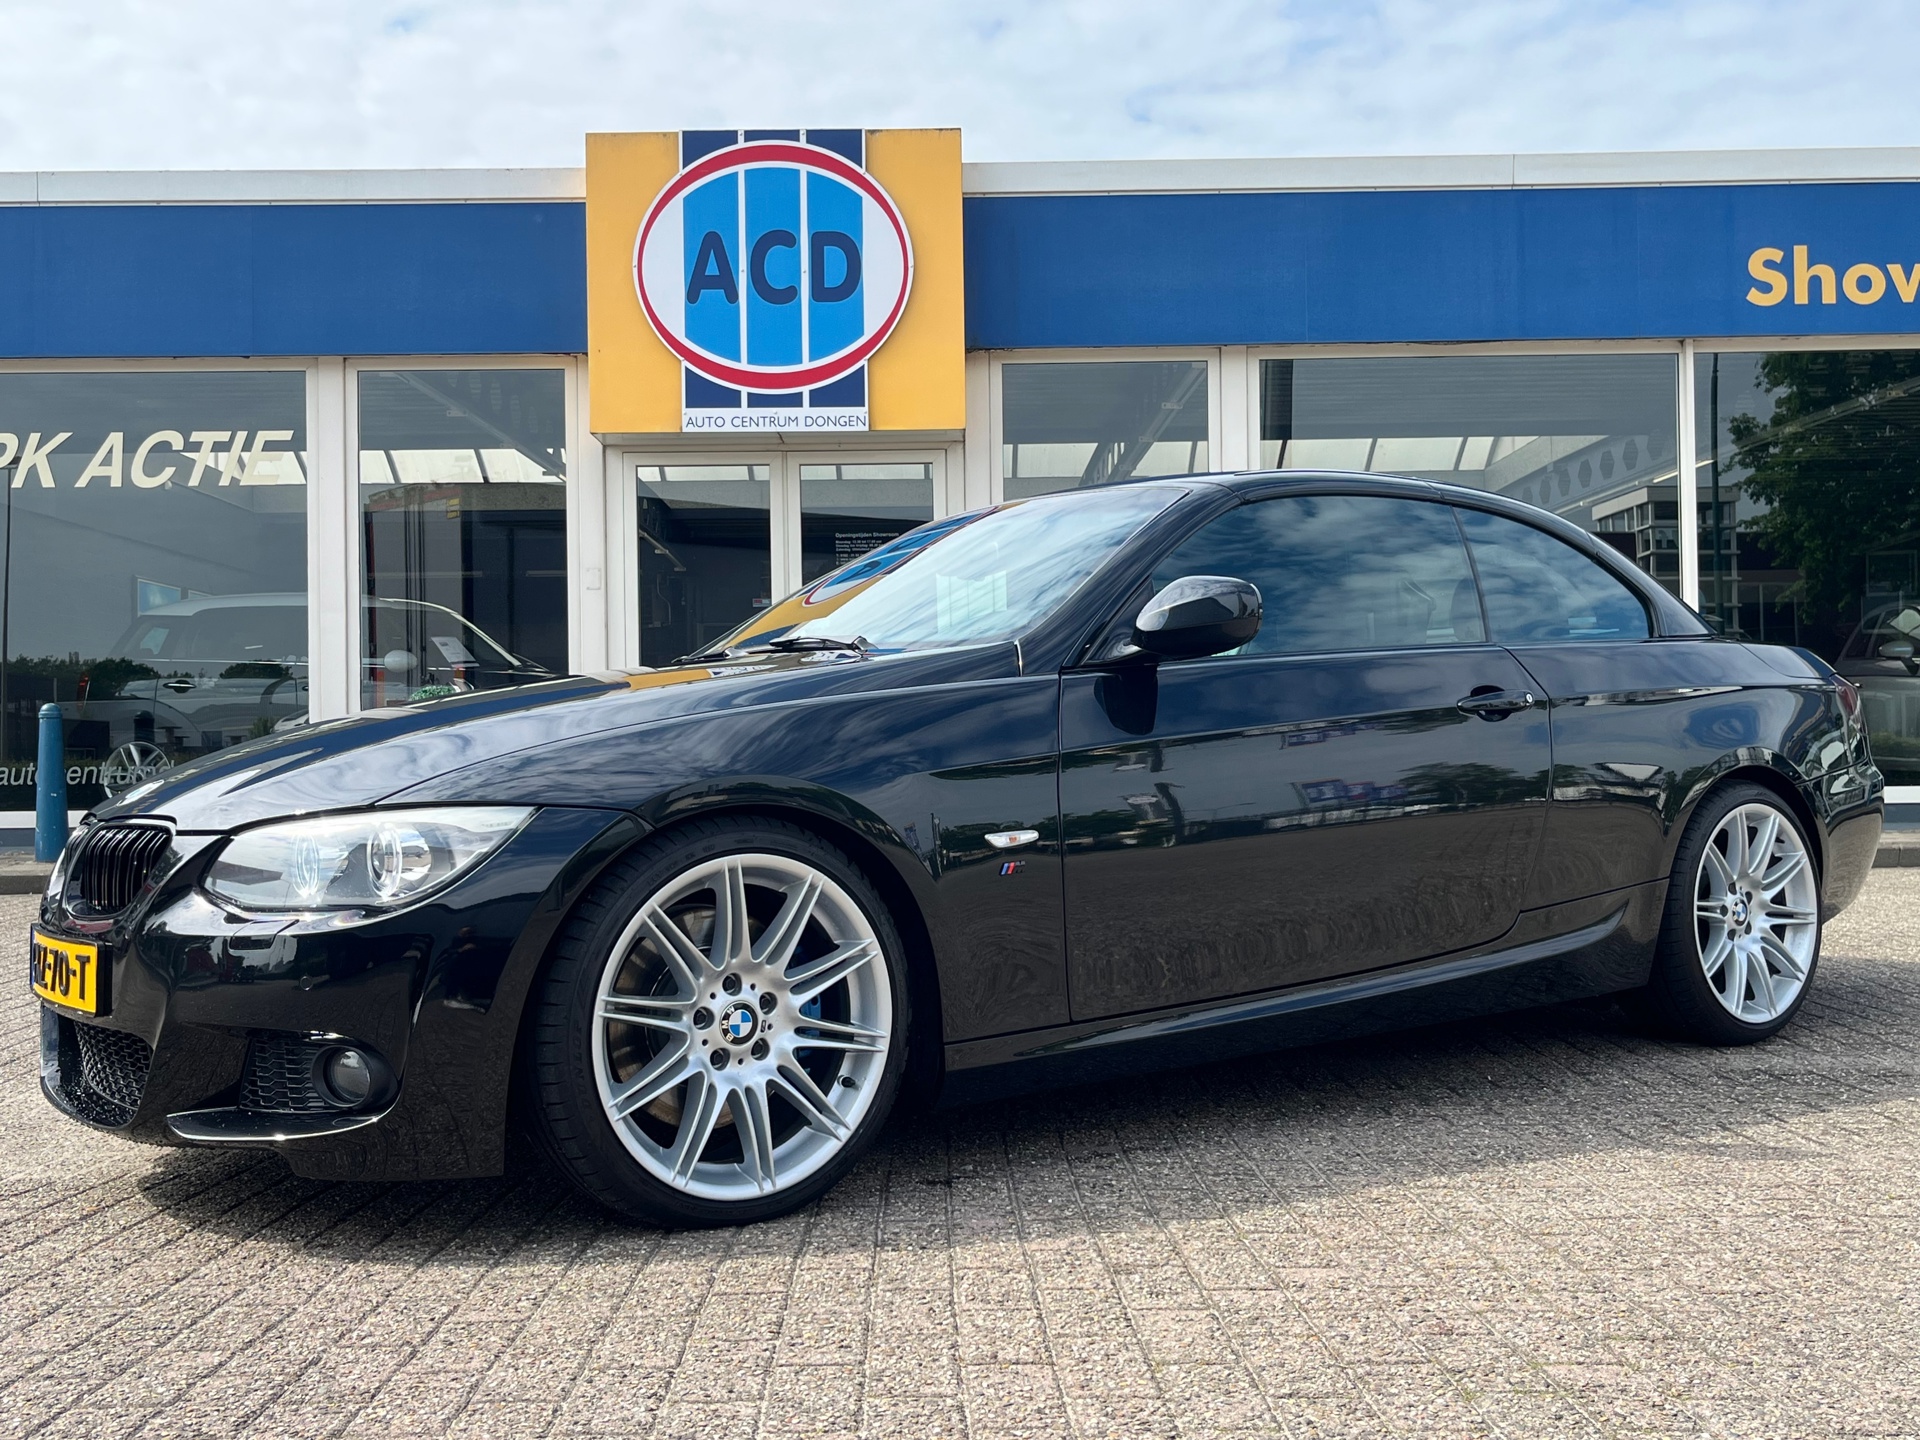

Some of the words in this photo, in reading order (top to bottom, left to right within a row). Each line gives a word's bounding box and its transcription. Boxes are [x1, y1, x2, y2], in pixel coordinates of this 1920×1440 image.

[686, 229, 862, 305] ACD
[685, 416, 726, 428] AUTO
[731, 415, 799, 428] CENTRUM
[804, 415, 867, 428] DONGEN
[74, 429, 294, 489] ACTIE
